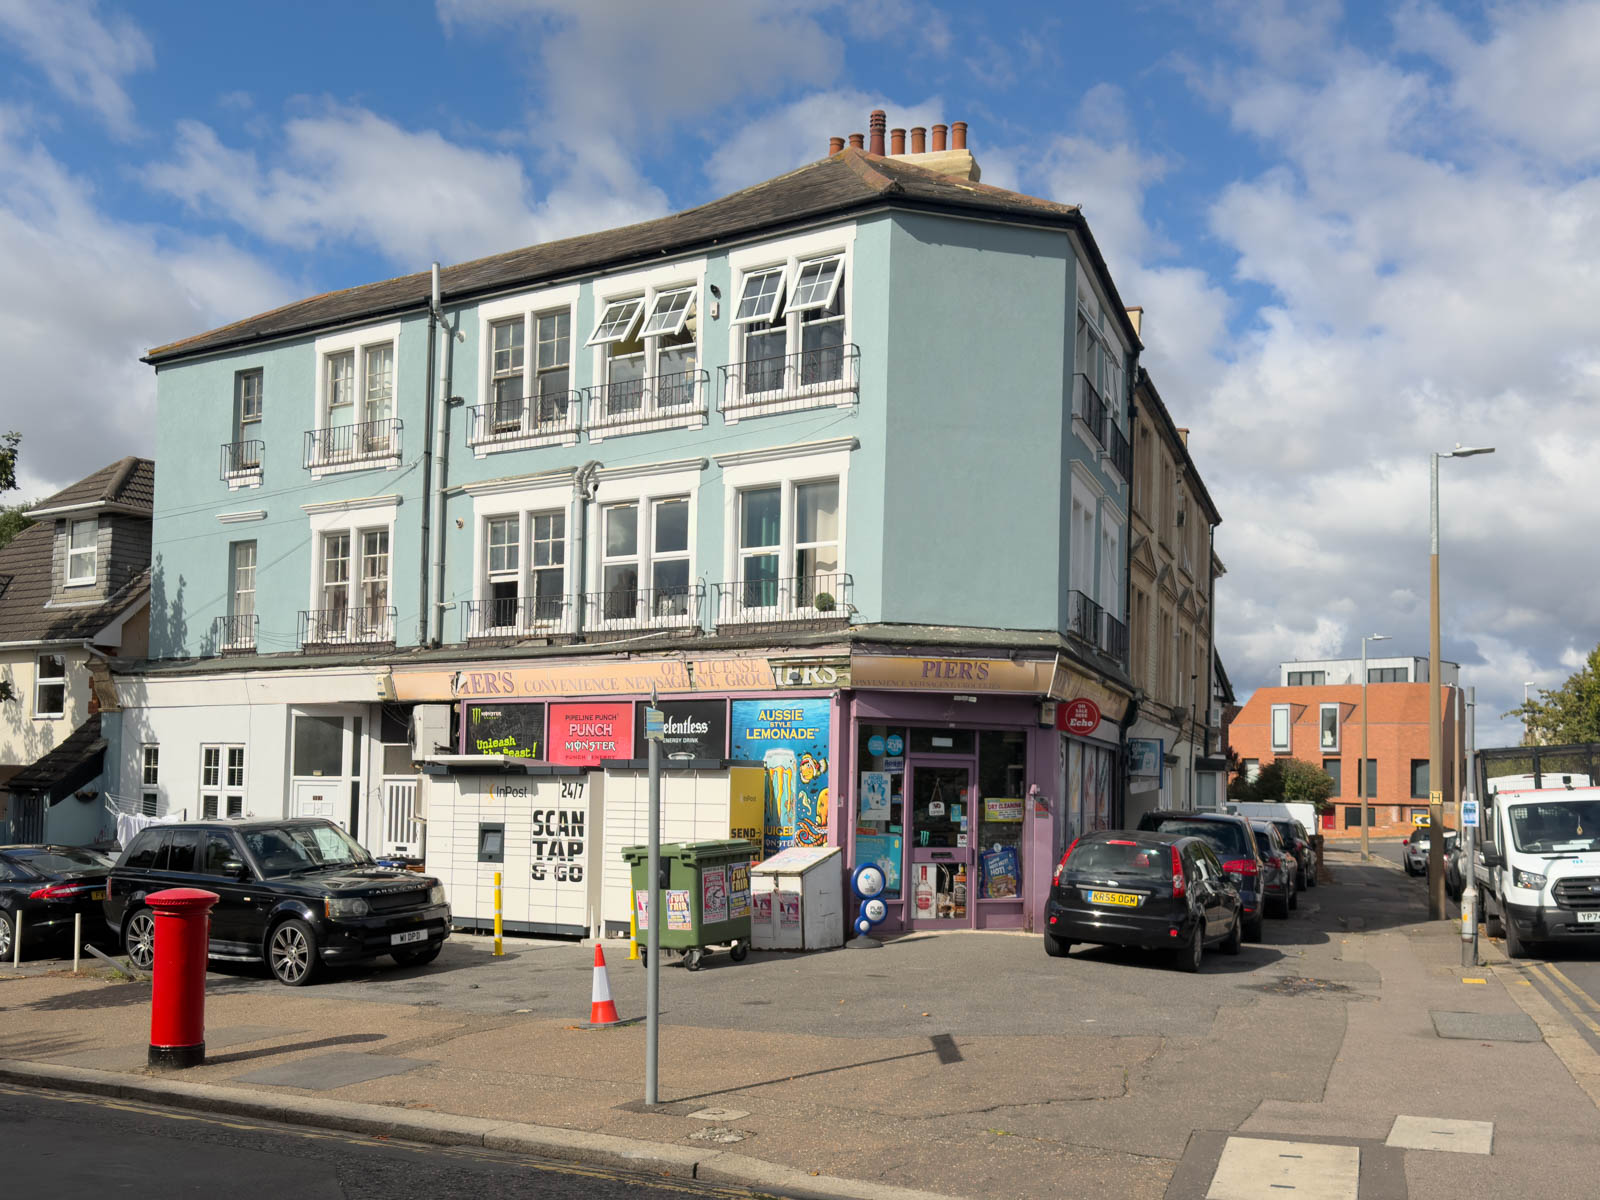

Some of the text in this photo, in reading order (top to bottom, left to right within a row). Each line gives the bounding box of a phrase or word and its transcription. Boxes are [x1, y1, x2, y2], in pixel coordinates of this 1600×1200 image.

[699, 658, 759, 674] LICENSE
[921, 660, 990, 680] PIER'S
[524, 678, 619, 692] CONVENIENCE
[758, 709, 804, 721] AUSSIE
[664, 715, 708, 734] elentless
[1070, 718, 1094, 727] Echo
[569, 723, 613, 736] PUNCH
[476, 735, 517, 750] Unleash
[496, 785, 528, 798] InPost
[561, 782, 584, 800] 24/7
[532, 810, 584, 837] SCAN
[731, 827, 756, 839] SEND
[766, 825, 794, 836] UICED
[532, 838, 584, 861] TAP
[531, 863, 583, 883] & GO
[732, 868, 746, 881] FUN
[731, 878, 748, 892] FAIR
[669, 894, 685, 904] FUN
[1093, 892, 1137, 905] KR55 OGM
[669, 901, 689, 911] FAIR
